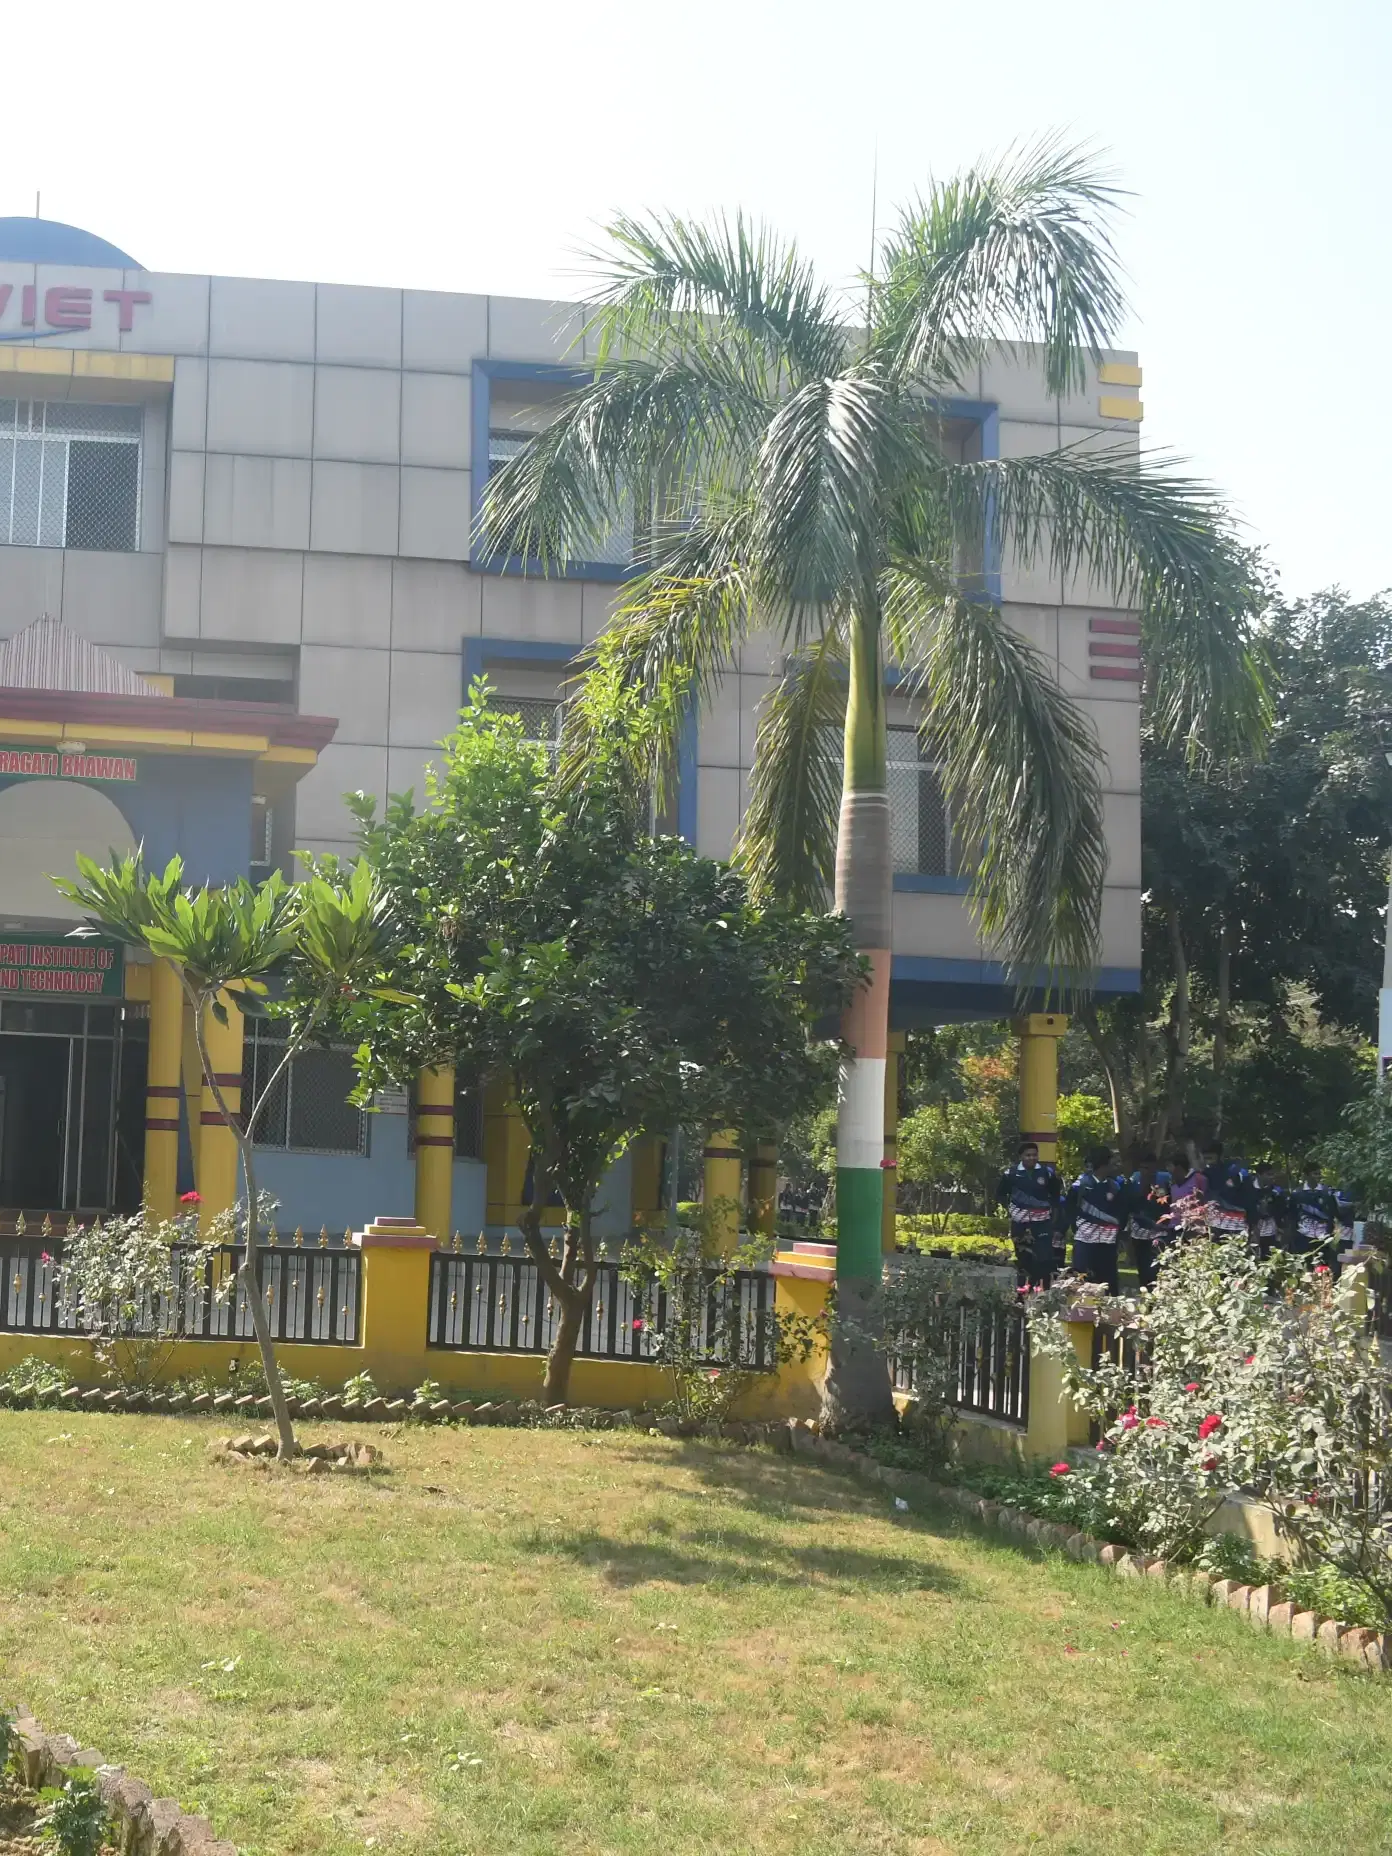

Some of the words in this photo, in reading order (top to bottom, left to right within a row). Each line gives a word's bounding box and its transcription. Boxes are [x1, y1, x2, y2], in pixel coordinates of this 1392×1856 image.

[61, 755, 137, 781] BHAWAN
[29, 945, 96, 968] INSTITUTE
[96, 949, 115, 970] OF
[20, 969, 105, 994] TECHNOLOGY
